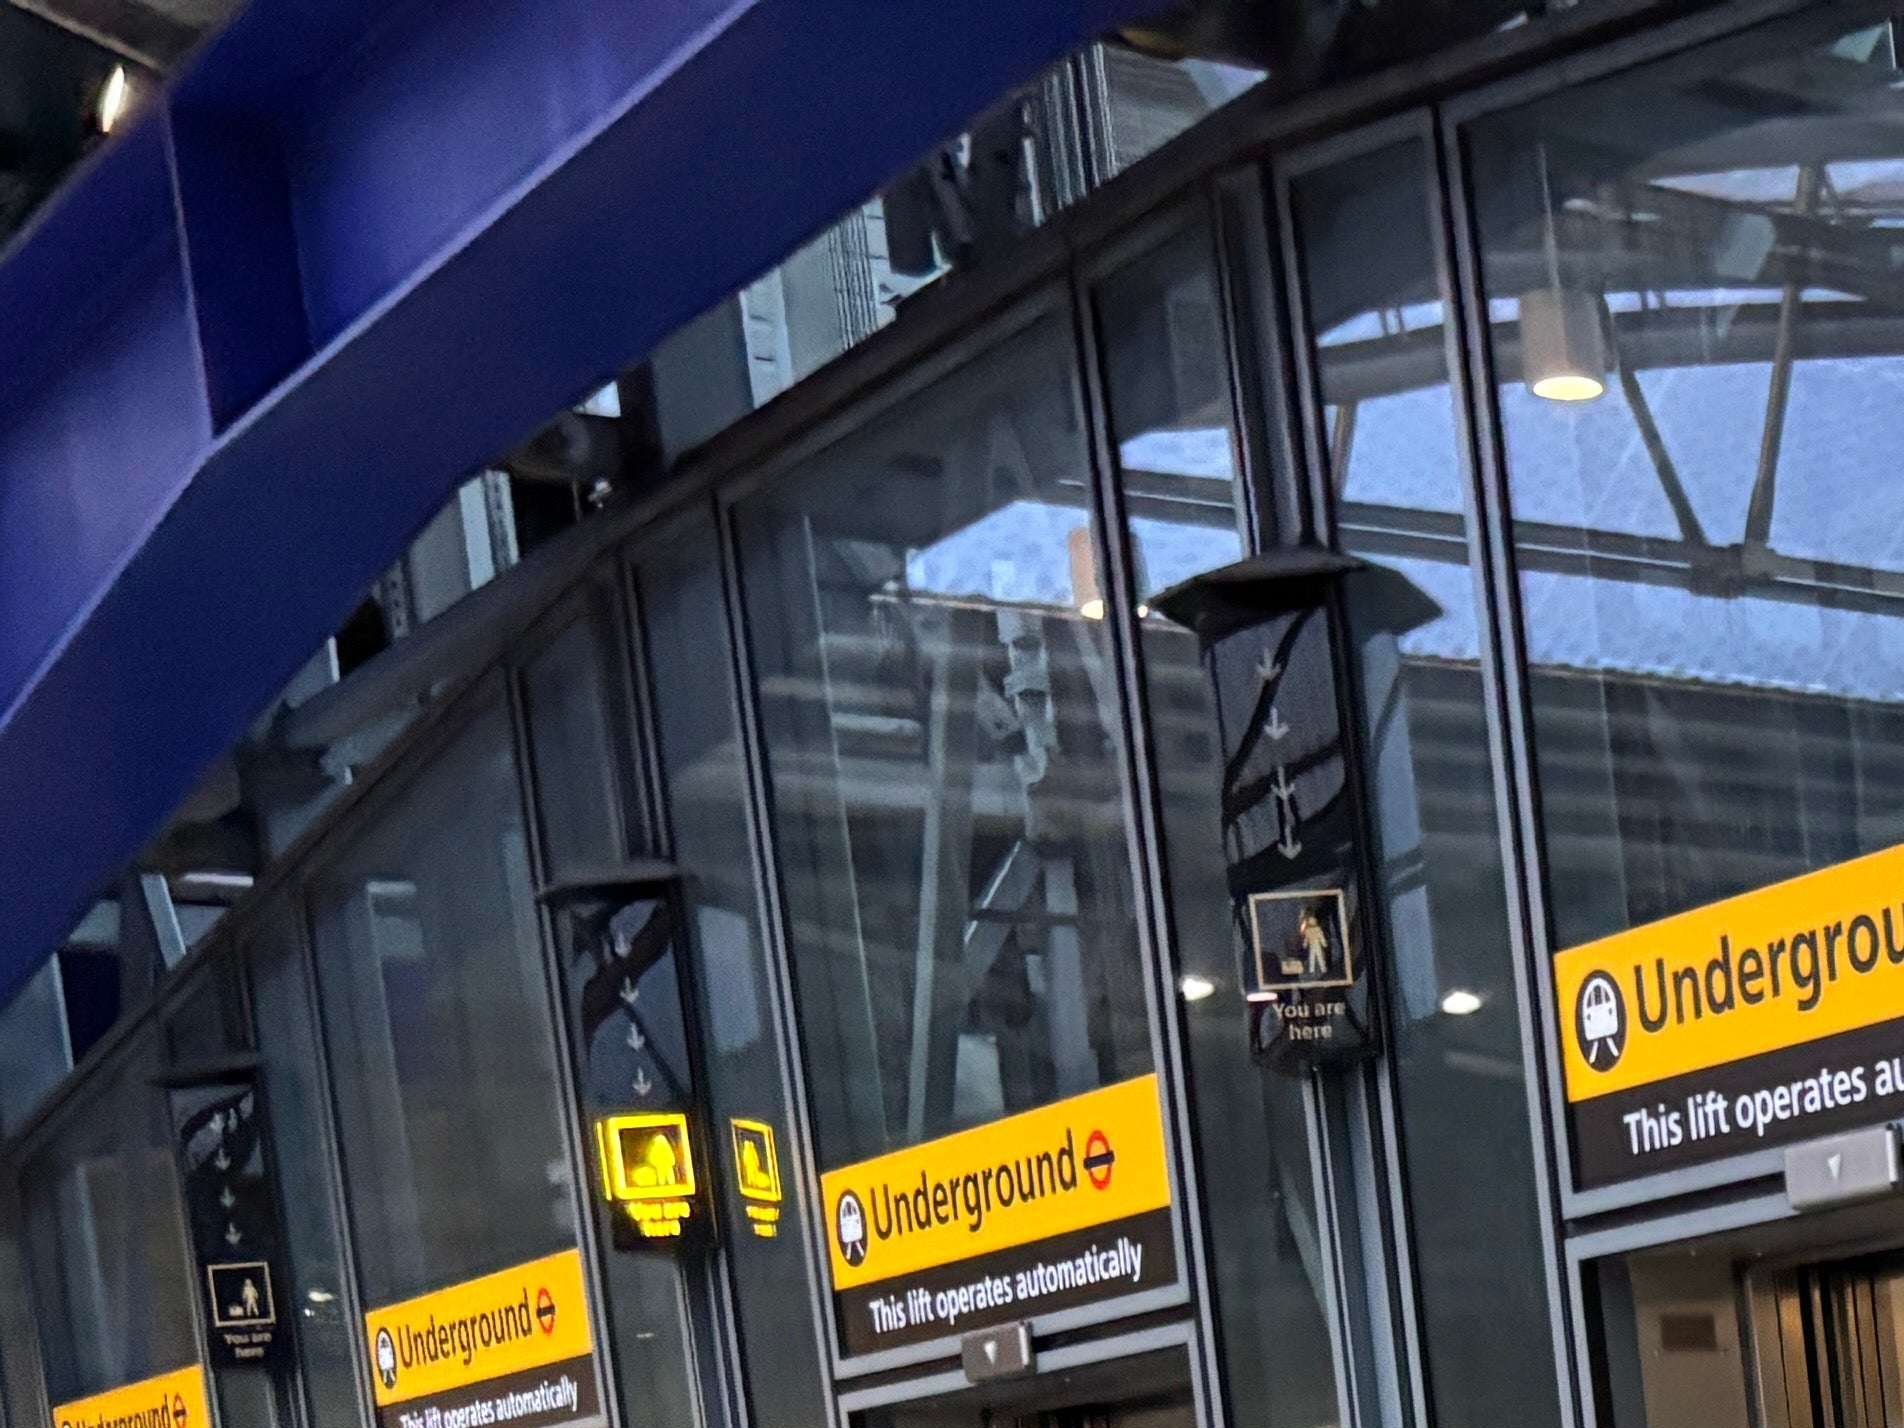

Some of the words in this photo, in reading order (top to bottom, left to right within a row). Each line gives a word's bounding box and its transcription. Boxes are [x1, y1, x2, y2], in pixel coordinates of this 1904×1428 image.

[1272, 1002, 1311, 1020] You
[1313, 1002, 1347, 1017] are
[1288, 1023, 1333, 1040] here
[1623, 1103, 1683, 1157] This
[1688, 1093, 1728, 1141] lift
[1735, 1066, 1869, 1138] operates
[870, 1126, 1078, 1241] Underground
[868, 1293, 906, 1335] This
[906, 1287, 935, 1326] lift
[935, 1271, 1014, 1326] operates
[1015, 1236, 1143, 1298] automatically
[397, 1286, 533, 1370] Underground
[495, 1374, 579, 1422] automatically
